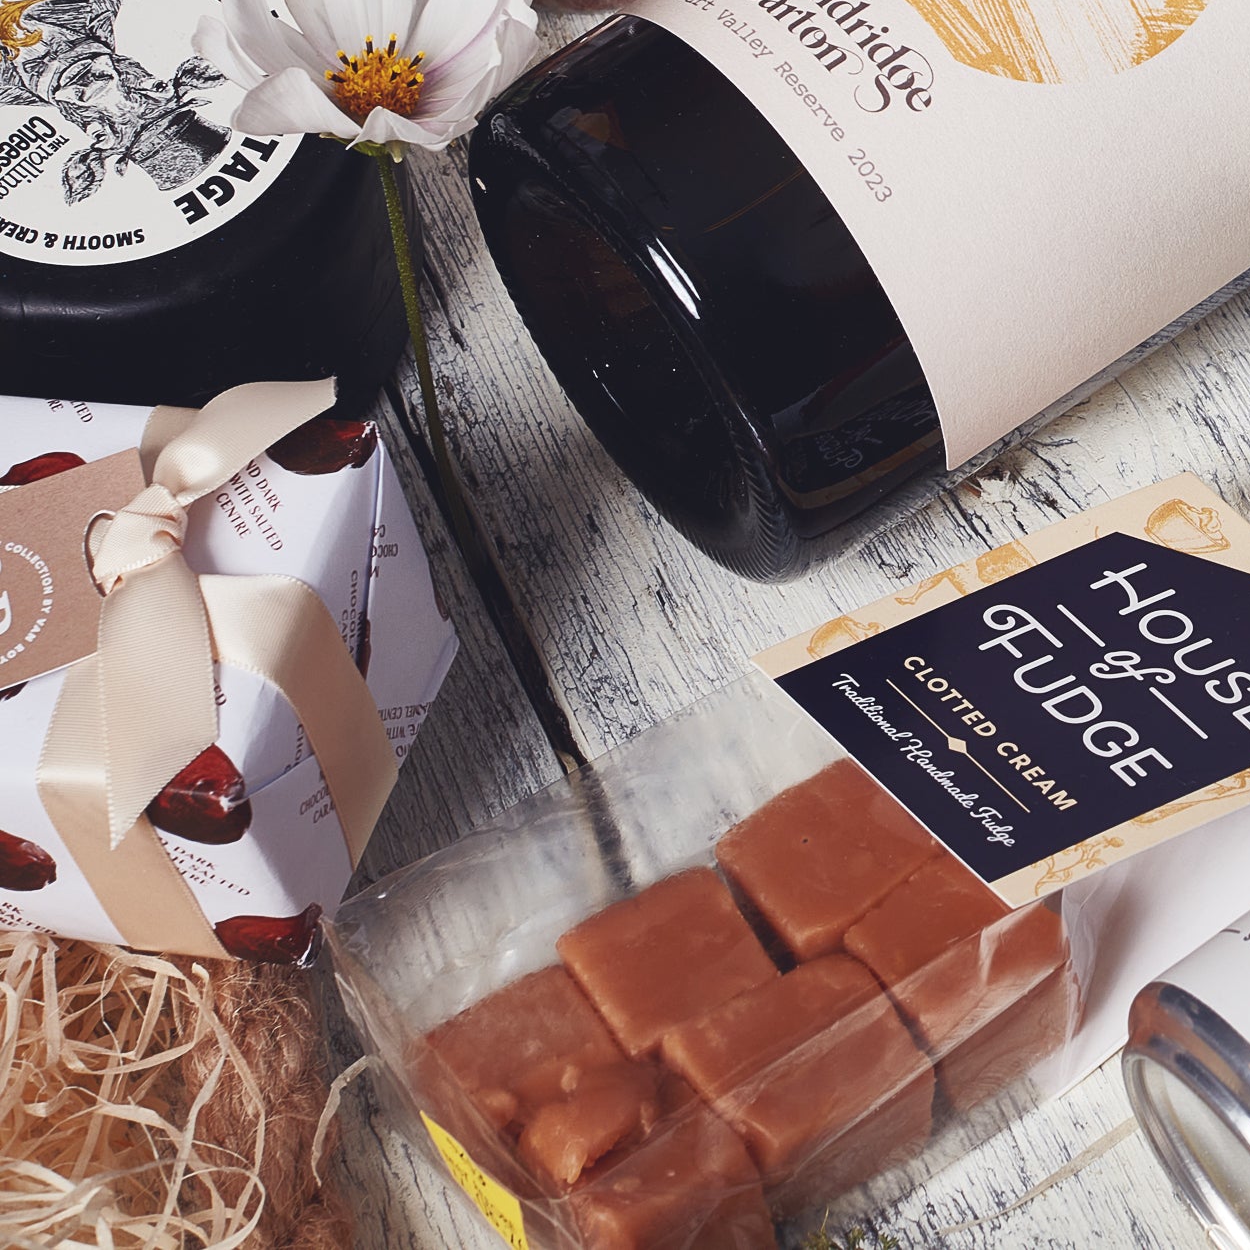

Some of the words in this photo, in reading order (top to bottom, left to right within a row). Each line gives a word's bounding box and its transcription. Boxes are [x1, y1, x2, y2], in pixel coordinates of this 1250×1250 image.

[716, 8, 774, 60] Valley
[773, 60, 846, 143] Reserve
[847, 148, 893, 203] 2023
[48, 134, 70, 153] THE
[174, 134, 280, 225] TAGE
[0, 217, 39, 244] CREA
[43, 232, 59, 249] &
[62, 228, 145, 251] SMOOTH
[245, 459, 261, 479] ND
[256, 478, 284, 513] DARK
[216, 492, 251, 539] CENTRE
[229, 472, 255, 506] WITH
[249, 505, 284, 551] SALTED
[4, 541, 54, 595] COLLECTION
[41, 598, 53, 614] BY
[25, 618, 48, 643] VAN
[1089, 647, 1177, 689] of
[978, 603, 1174, 789] FUDGE
[903, 655, 997, 740] CLOTTED
[996, 740, 1079, 813] CREAM
[831, 672, 914, 744] Traditional
[900, 737, 976, 809] Handmade
[969, 803, 1017, 849] Fudge
[173, 846, 216, 870] DARK
[188, 864, 250, 896] SALTED
